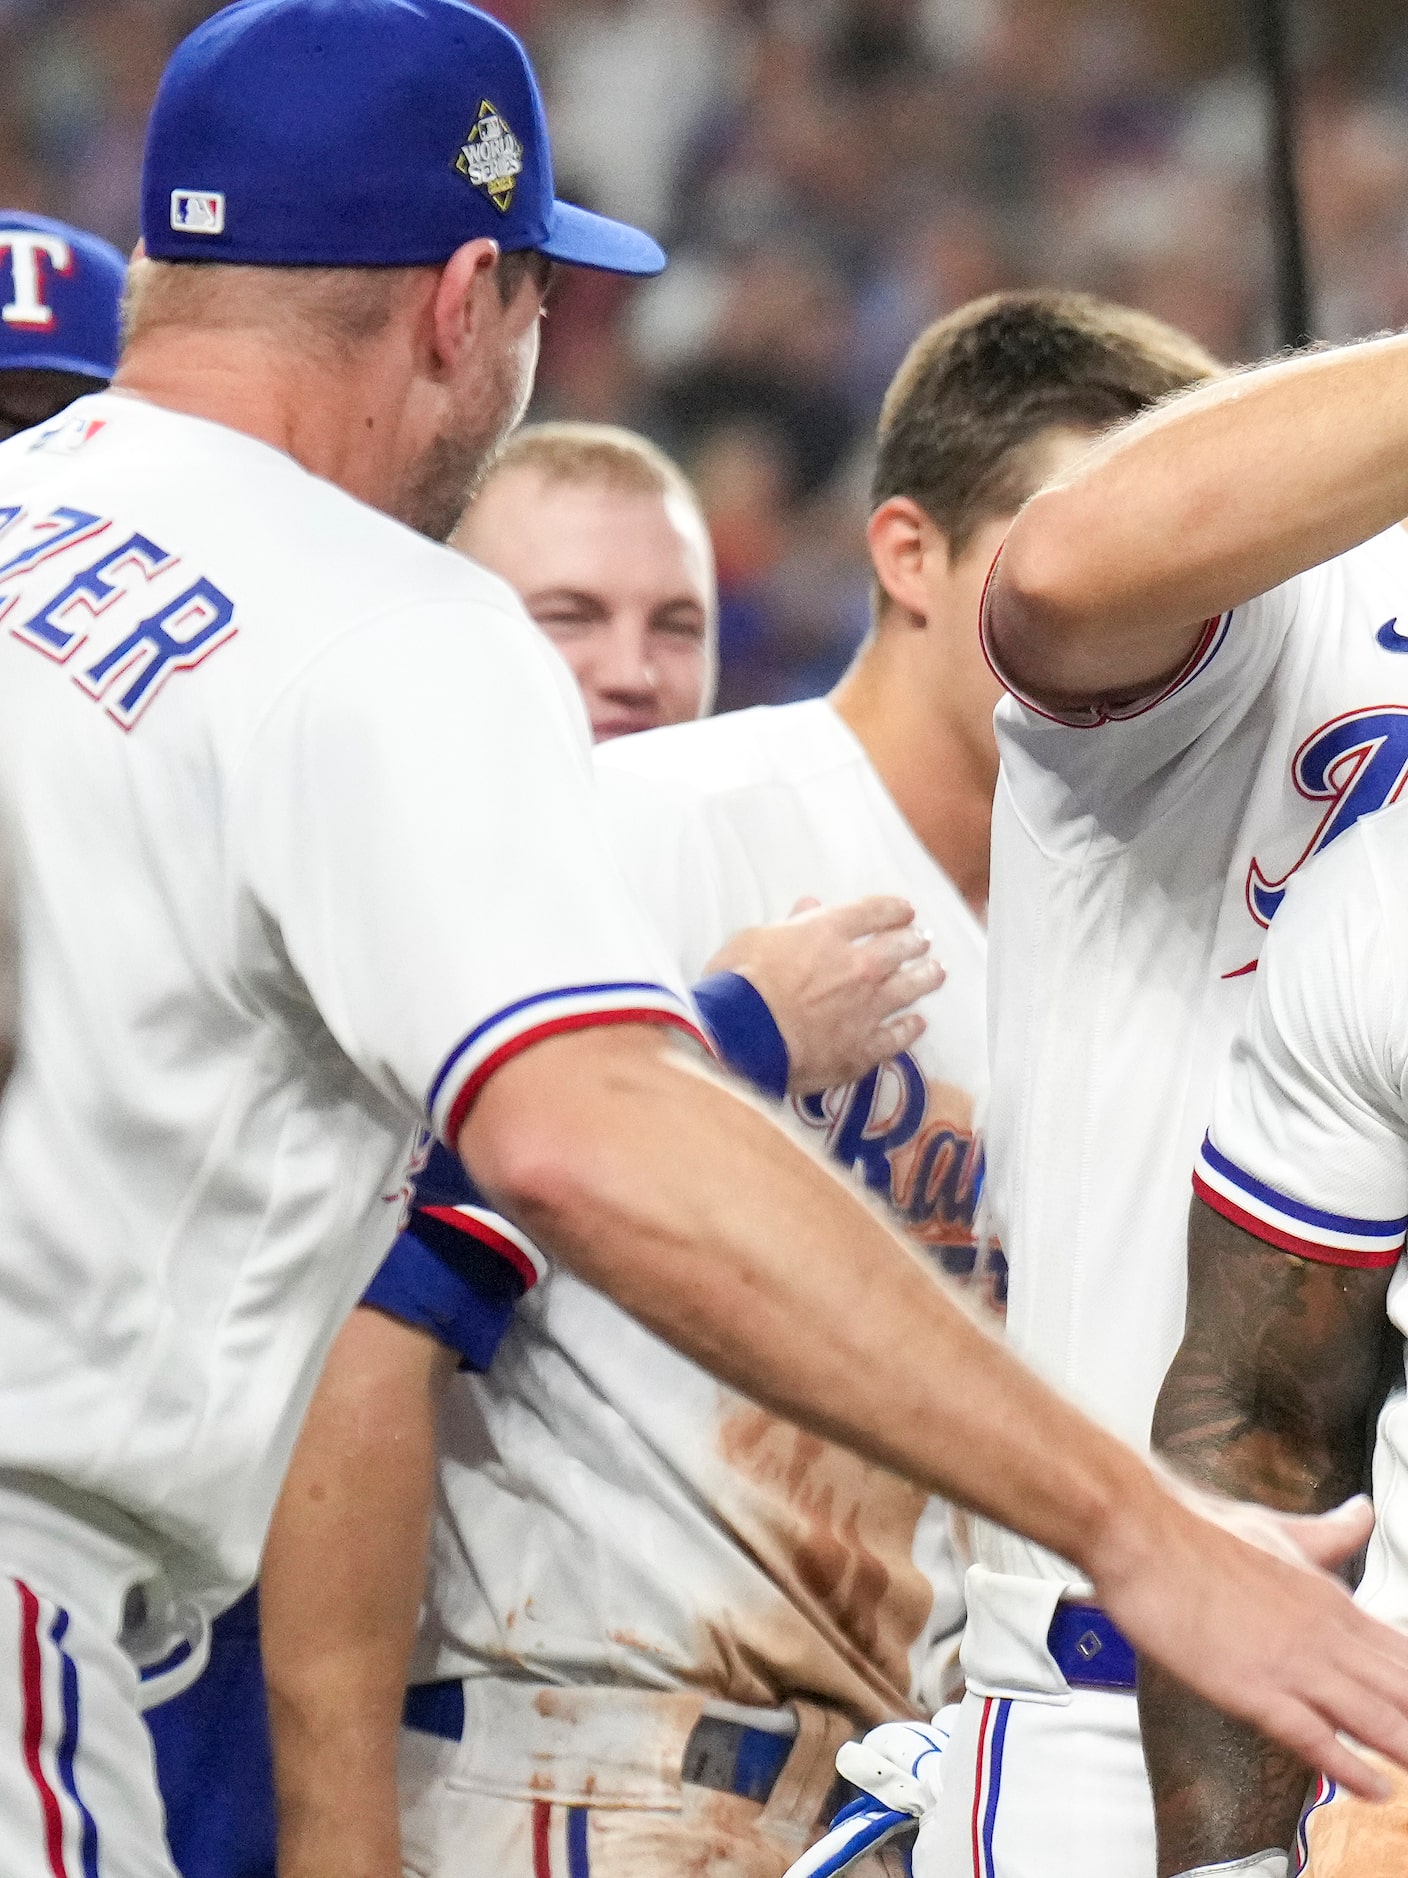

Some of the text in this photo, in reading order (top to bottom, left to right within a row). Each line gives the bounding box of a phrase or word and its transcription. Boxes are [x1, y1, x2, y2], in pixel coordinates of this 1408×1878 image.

[461, 133, 520, 164] WORLD
[0, 230, 76, 333] T
[0, 505, 239, 735] ZER
[790, 1050, 987, 1240] Ra
